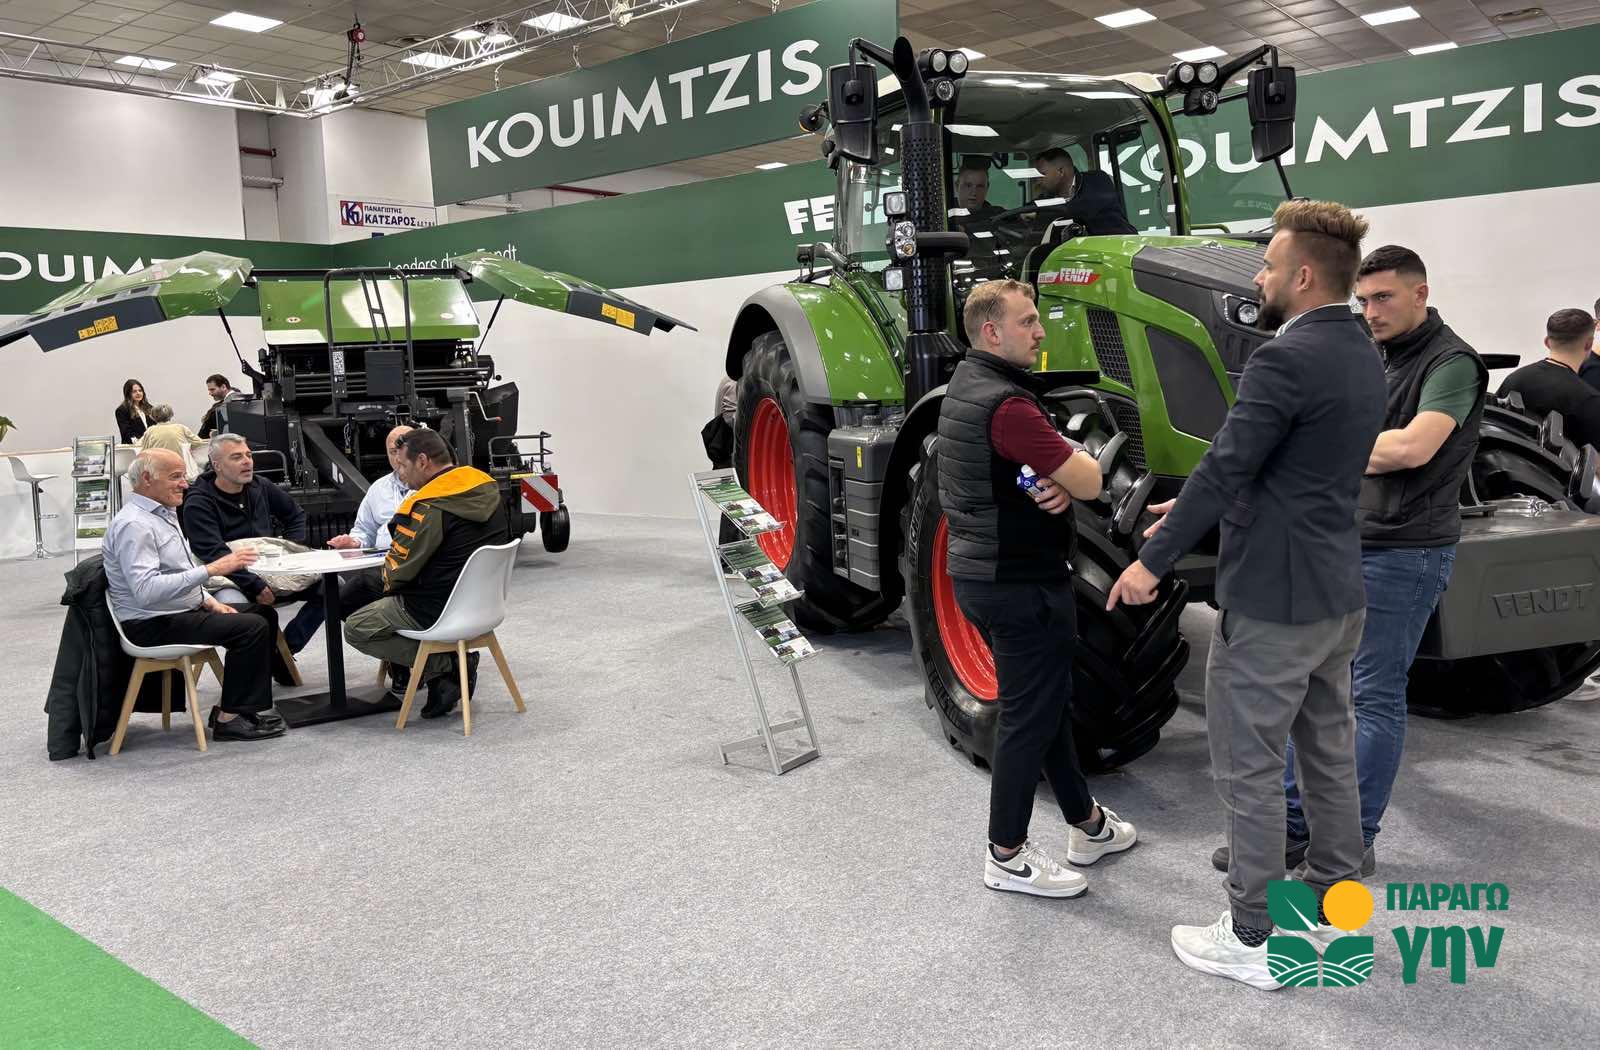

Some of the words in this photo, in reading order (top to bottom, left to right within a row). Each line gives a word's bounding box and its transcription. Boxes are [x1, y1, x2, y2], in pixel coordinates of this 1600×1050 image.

[467, 39, 822, 169] KOUIMTZIS
[365, 214, 416, 226] ΚΑΤΣΑΡΟΣ
[1060, 267, 1094, 283] FENDT
[1492, 582, 1593, 619] FENDT
